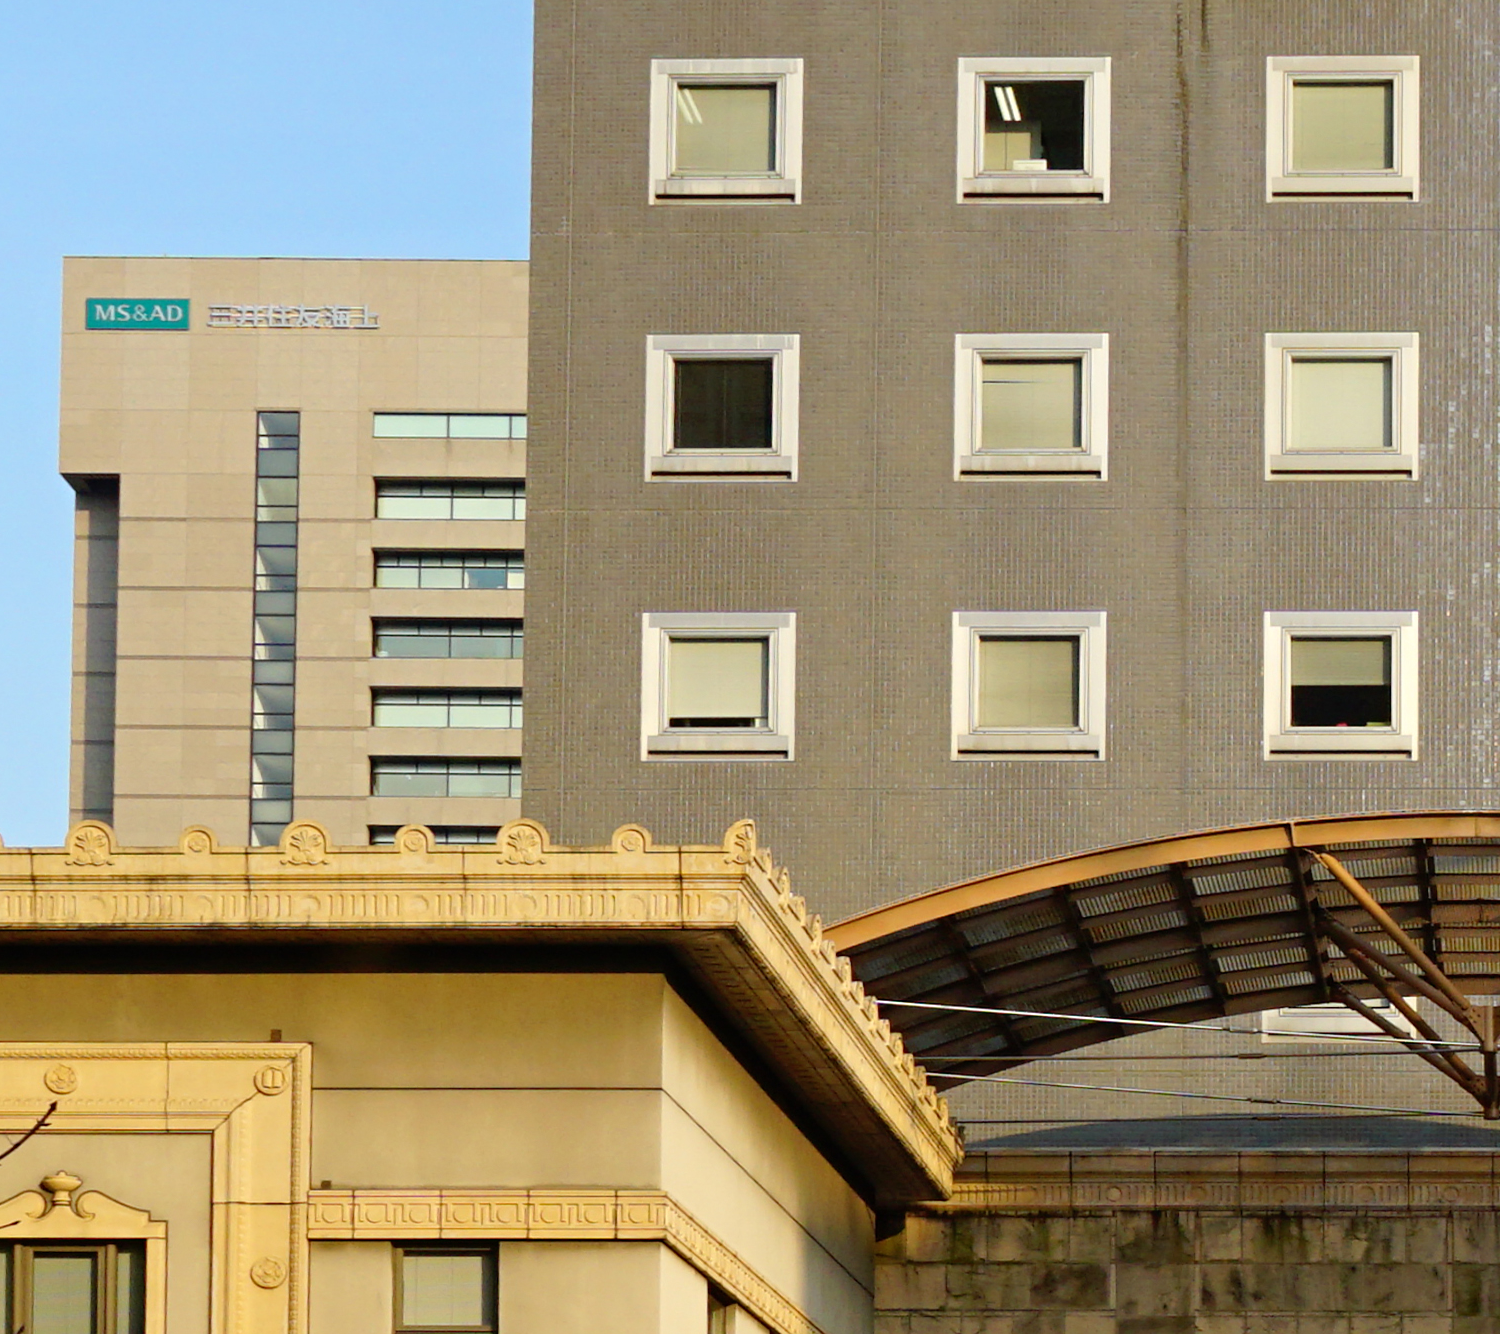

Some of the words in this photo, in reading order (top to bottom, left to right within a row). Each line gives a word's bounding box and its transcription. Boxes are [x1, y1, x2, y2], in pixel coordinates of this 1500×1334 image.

[95, 303, 184, 323] MS&AD
[206, 304, 379, 328] 三井住友海上
